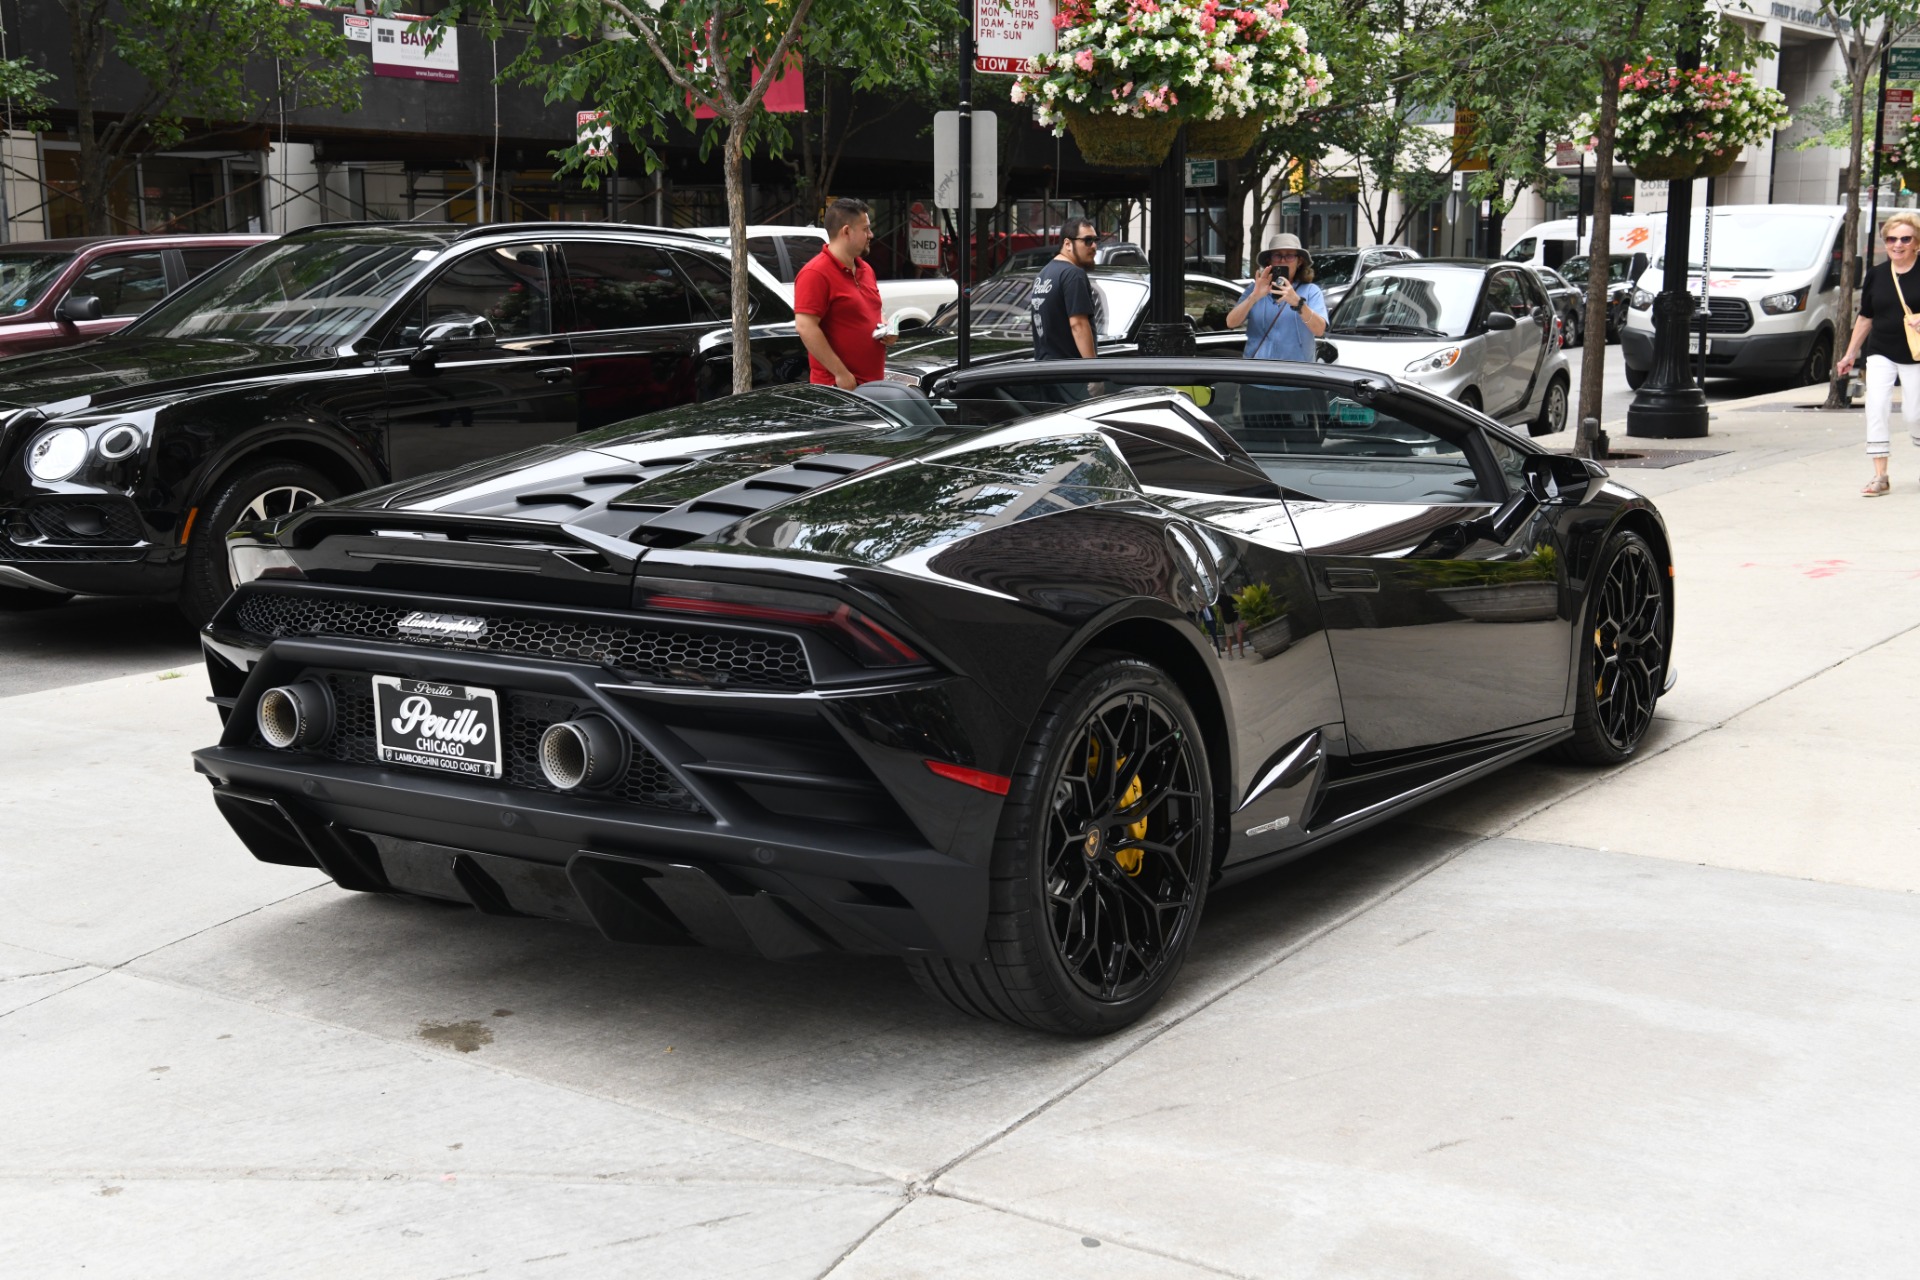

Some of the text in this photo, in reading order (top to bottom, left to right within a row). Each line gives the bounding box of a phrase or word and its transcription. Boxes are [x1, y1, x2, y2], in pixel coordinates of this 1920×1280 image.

[980, 7, 1000, 17] MON
[1011, 9, 1039, 20] THURS
[400, 31, 442, 48] BAM
[980, 29, 995, 38] FRI
[1003, 30, 1022, 40] SUN
[980, 58, 1050, 73] TOW ZO
[397, 612, 484, 634] Lamborghini
[413, 682, 453, 696] Perillo
[391, 696, 487, 745] Perillo
[416, 738, 465, 756] CHICAGO
[395, 752, 480, 773] LAMBORGHINI GOLD COAST
